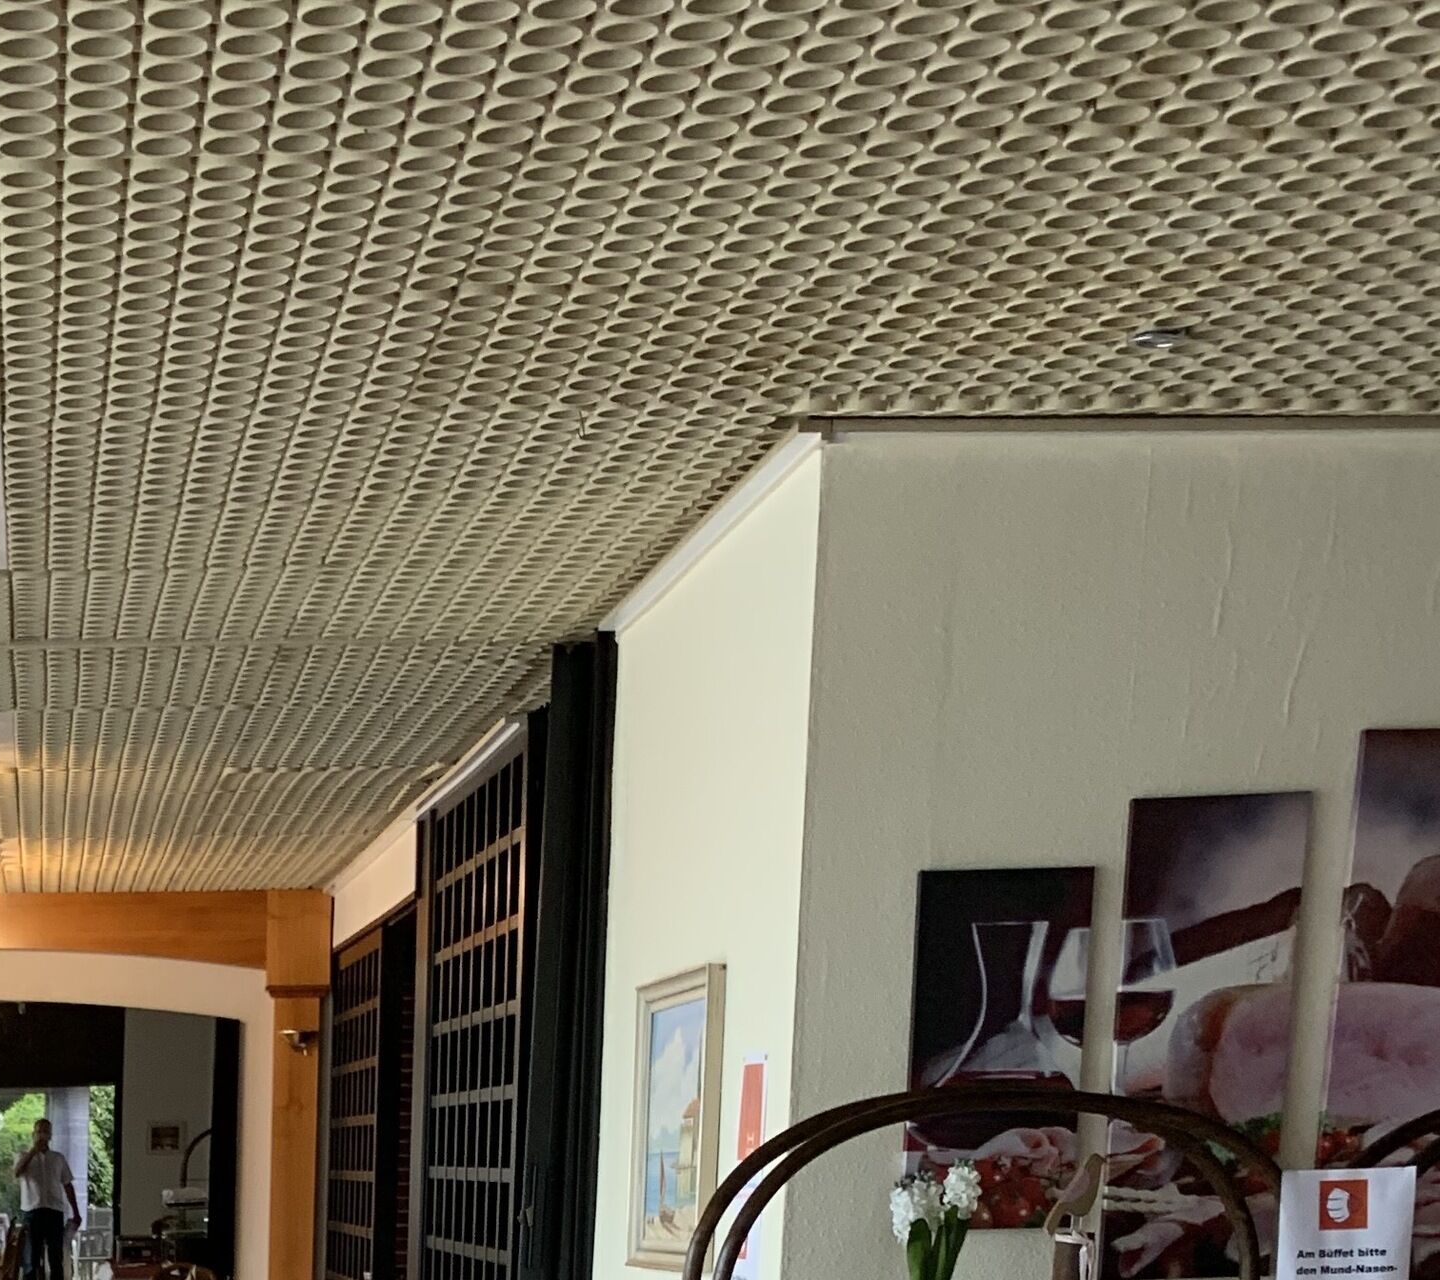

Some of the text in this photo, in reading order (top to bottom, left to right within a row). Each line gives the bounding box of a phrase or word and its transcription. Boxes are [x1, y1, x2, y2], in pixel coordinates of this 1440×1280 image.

[1297, 1249, 1315, 1258] Am
[1358, 1248, 1387, 1257] bitte
[1296, 1265, 1398, 1275] den Mund-Nasen-
